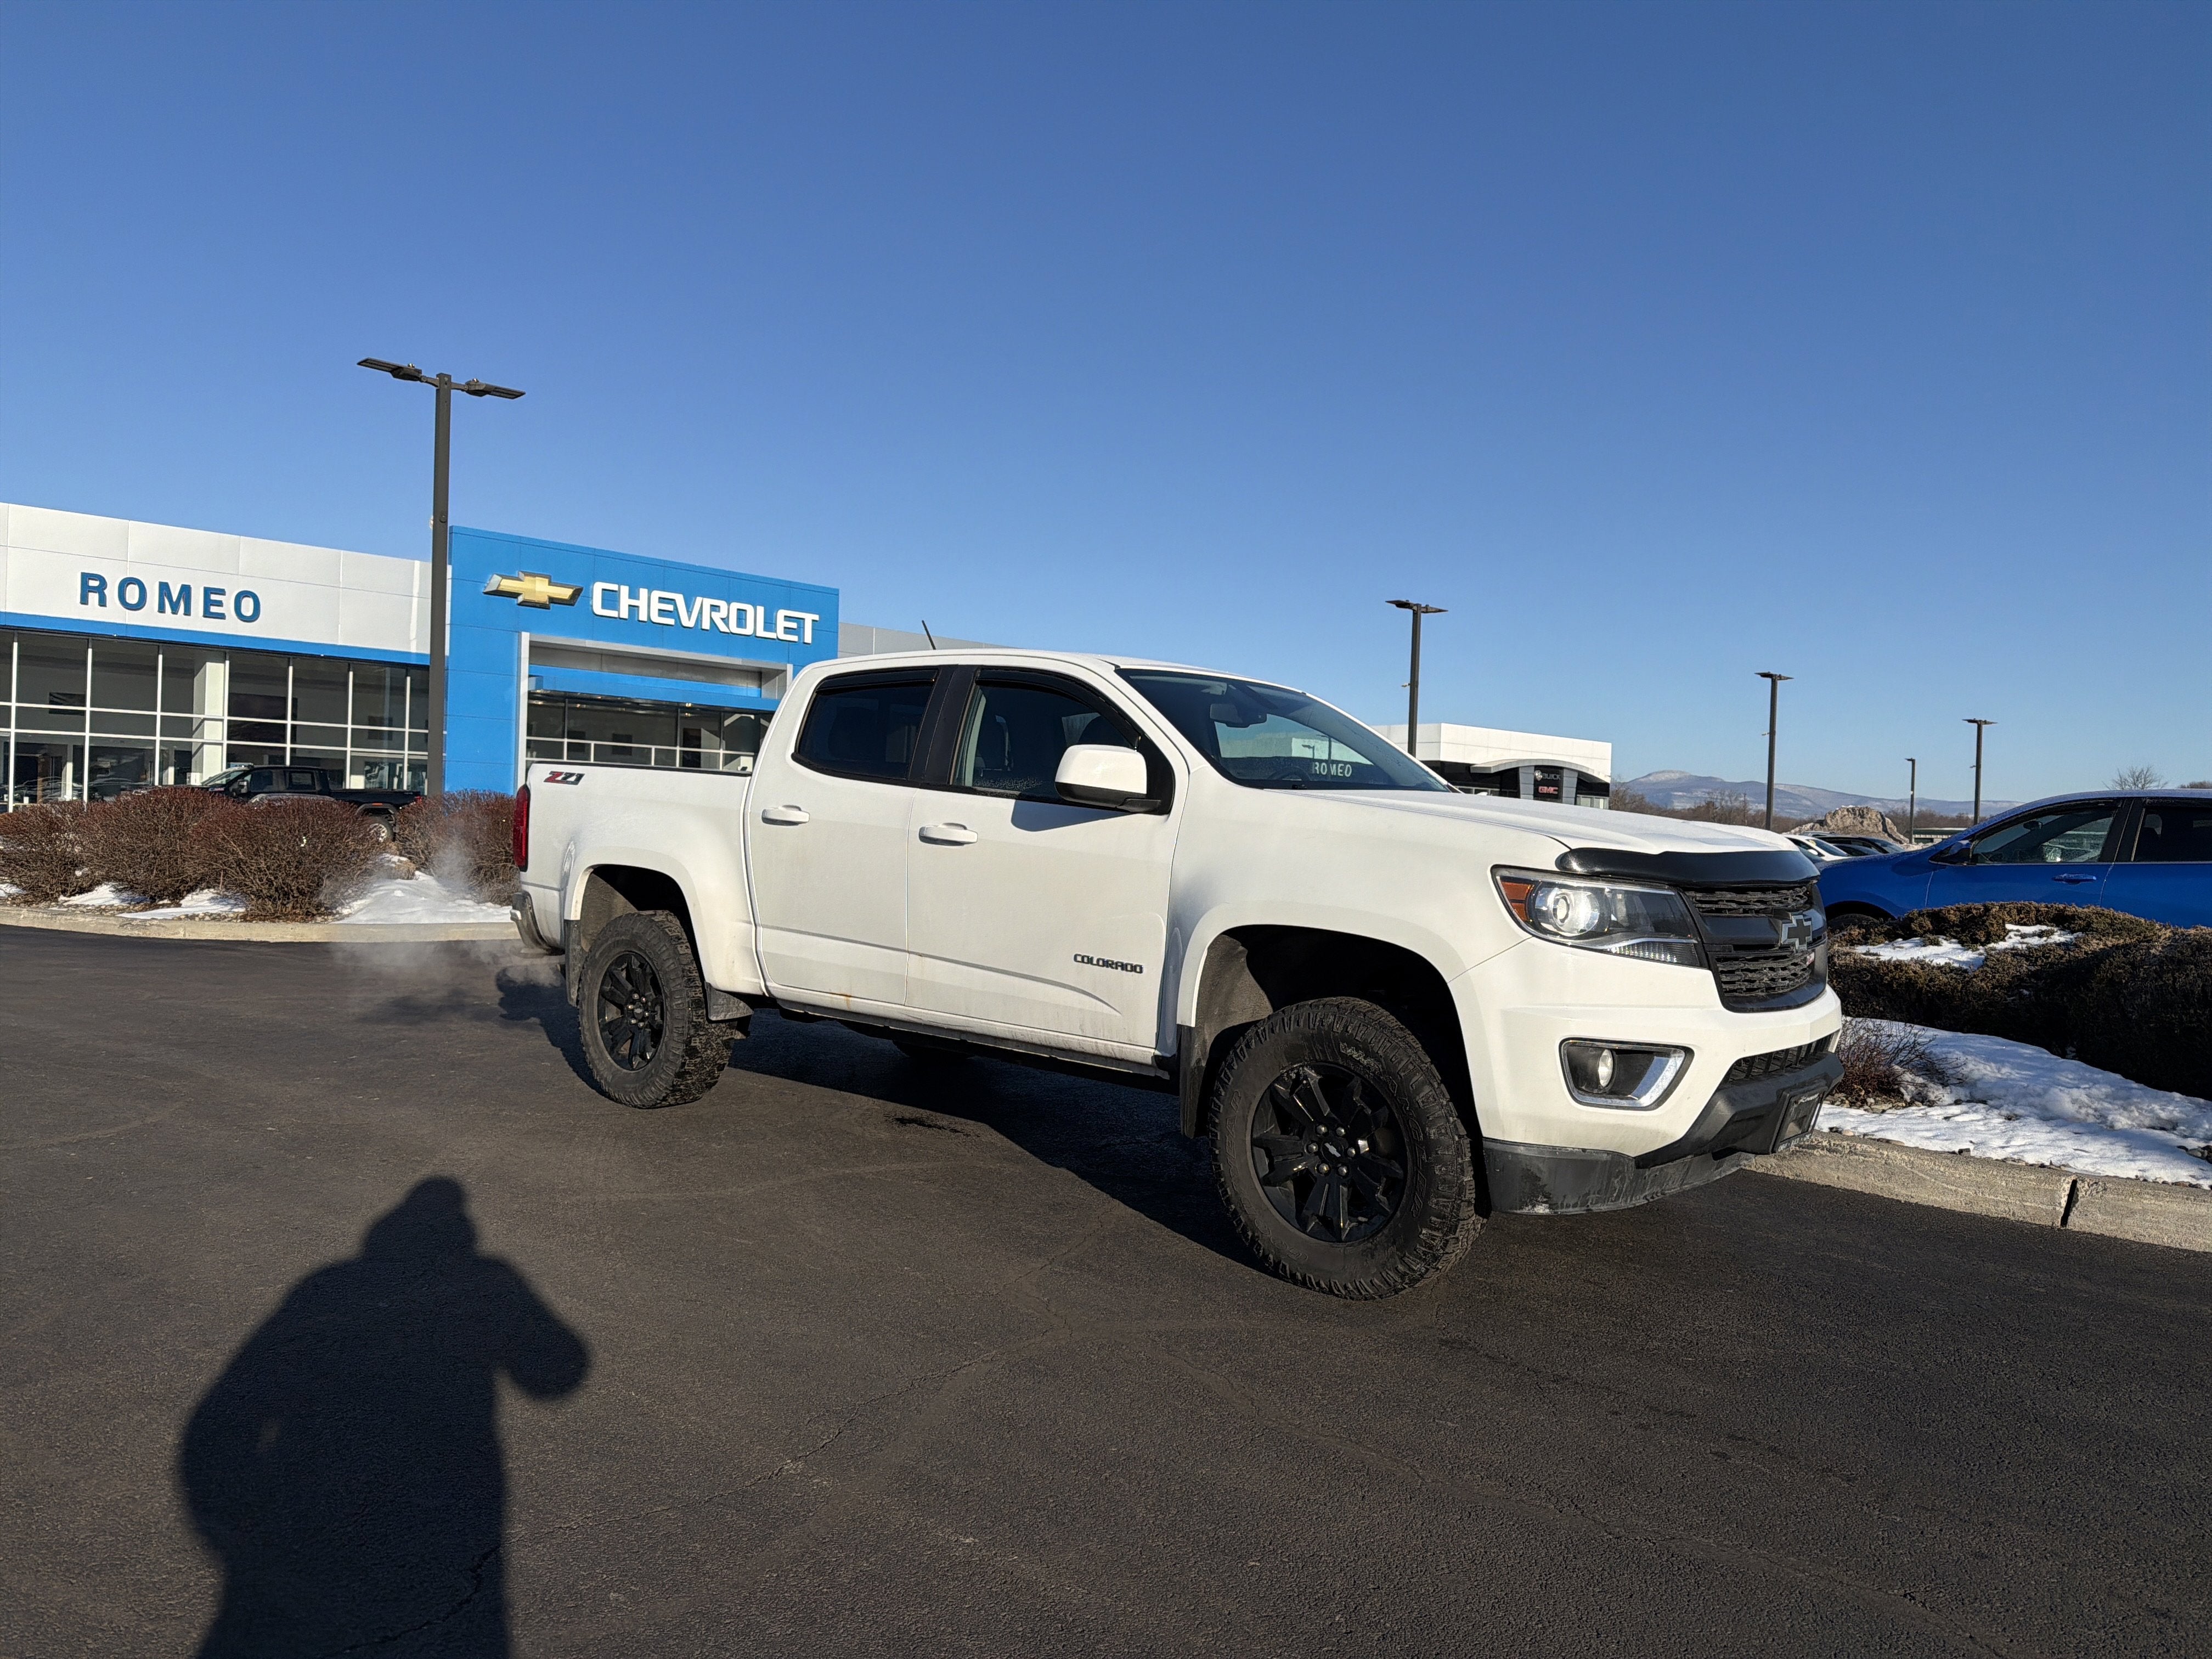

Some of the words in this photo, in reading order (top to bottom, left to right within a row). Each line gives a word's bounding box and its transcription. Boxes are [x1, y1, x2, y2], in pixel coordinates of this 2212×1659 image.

[80, 572, 261, 623] ROMEO
[592, 582, 819, 644] CHEVROLET
[544, 771, 585, 785] Z71
[1312, 762, 1352, 777] ROMEO
[1074, 953, 1143, 974] COLORADO
[1226, 1090, 1308, 1261] GOODYEAR
